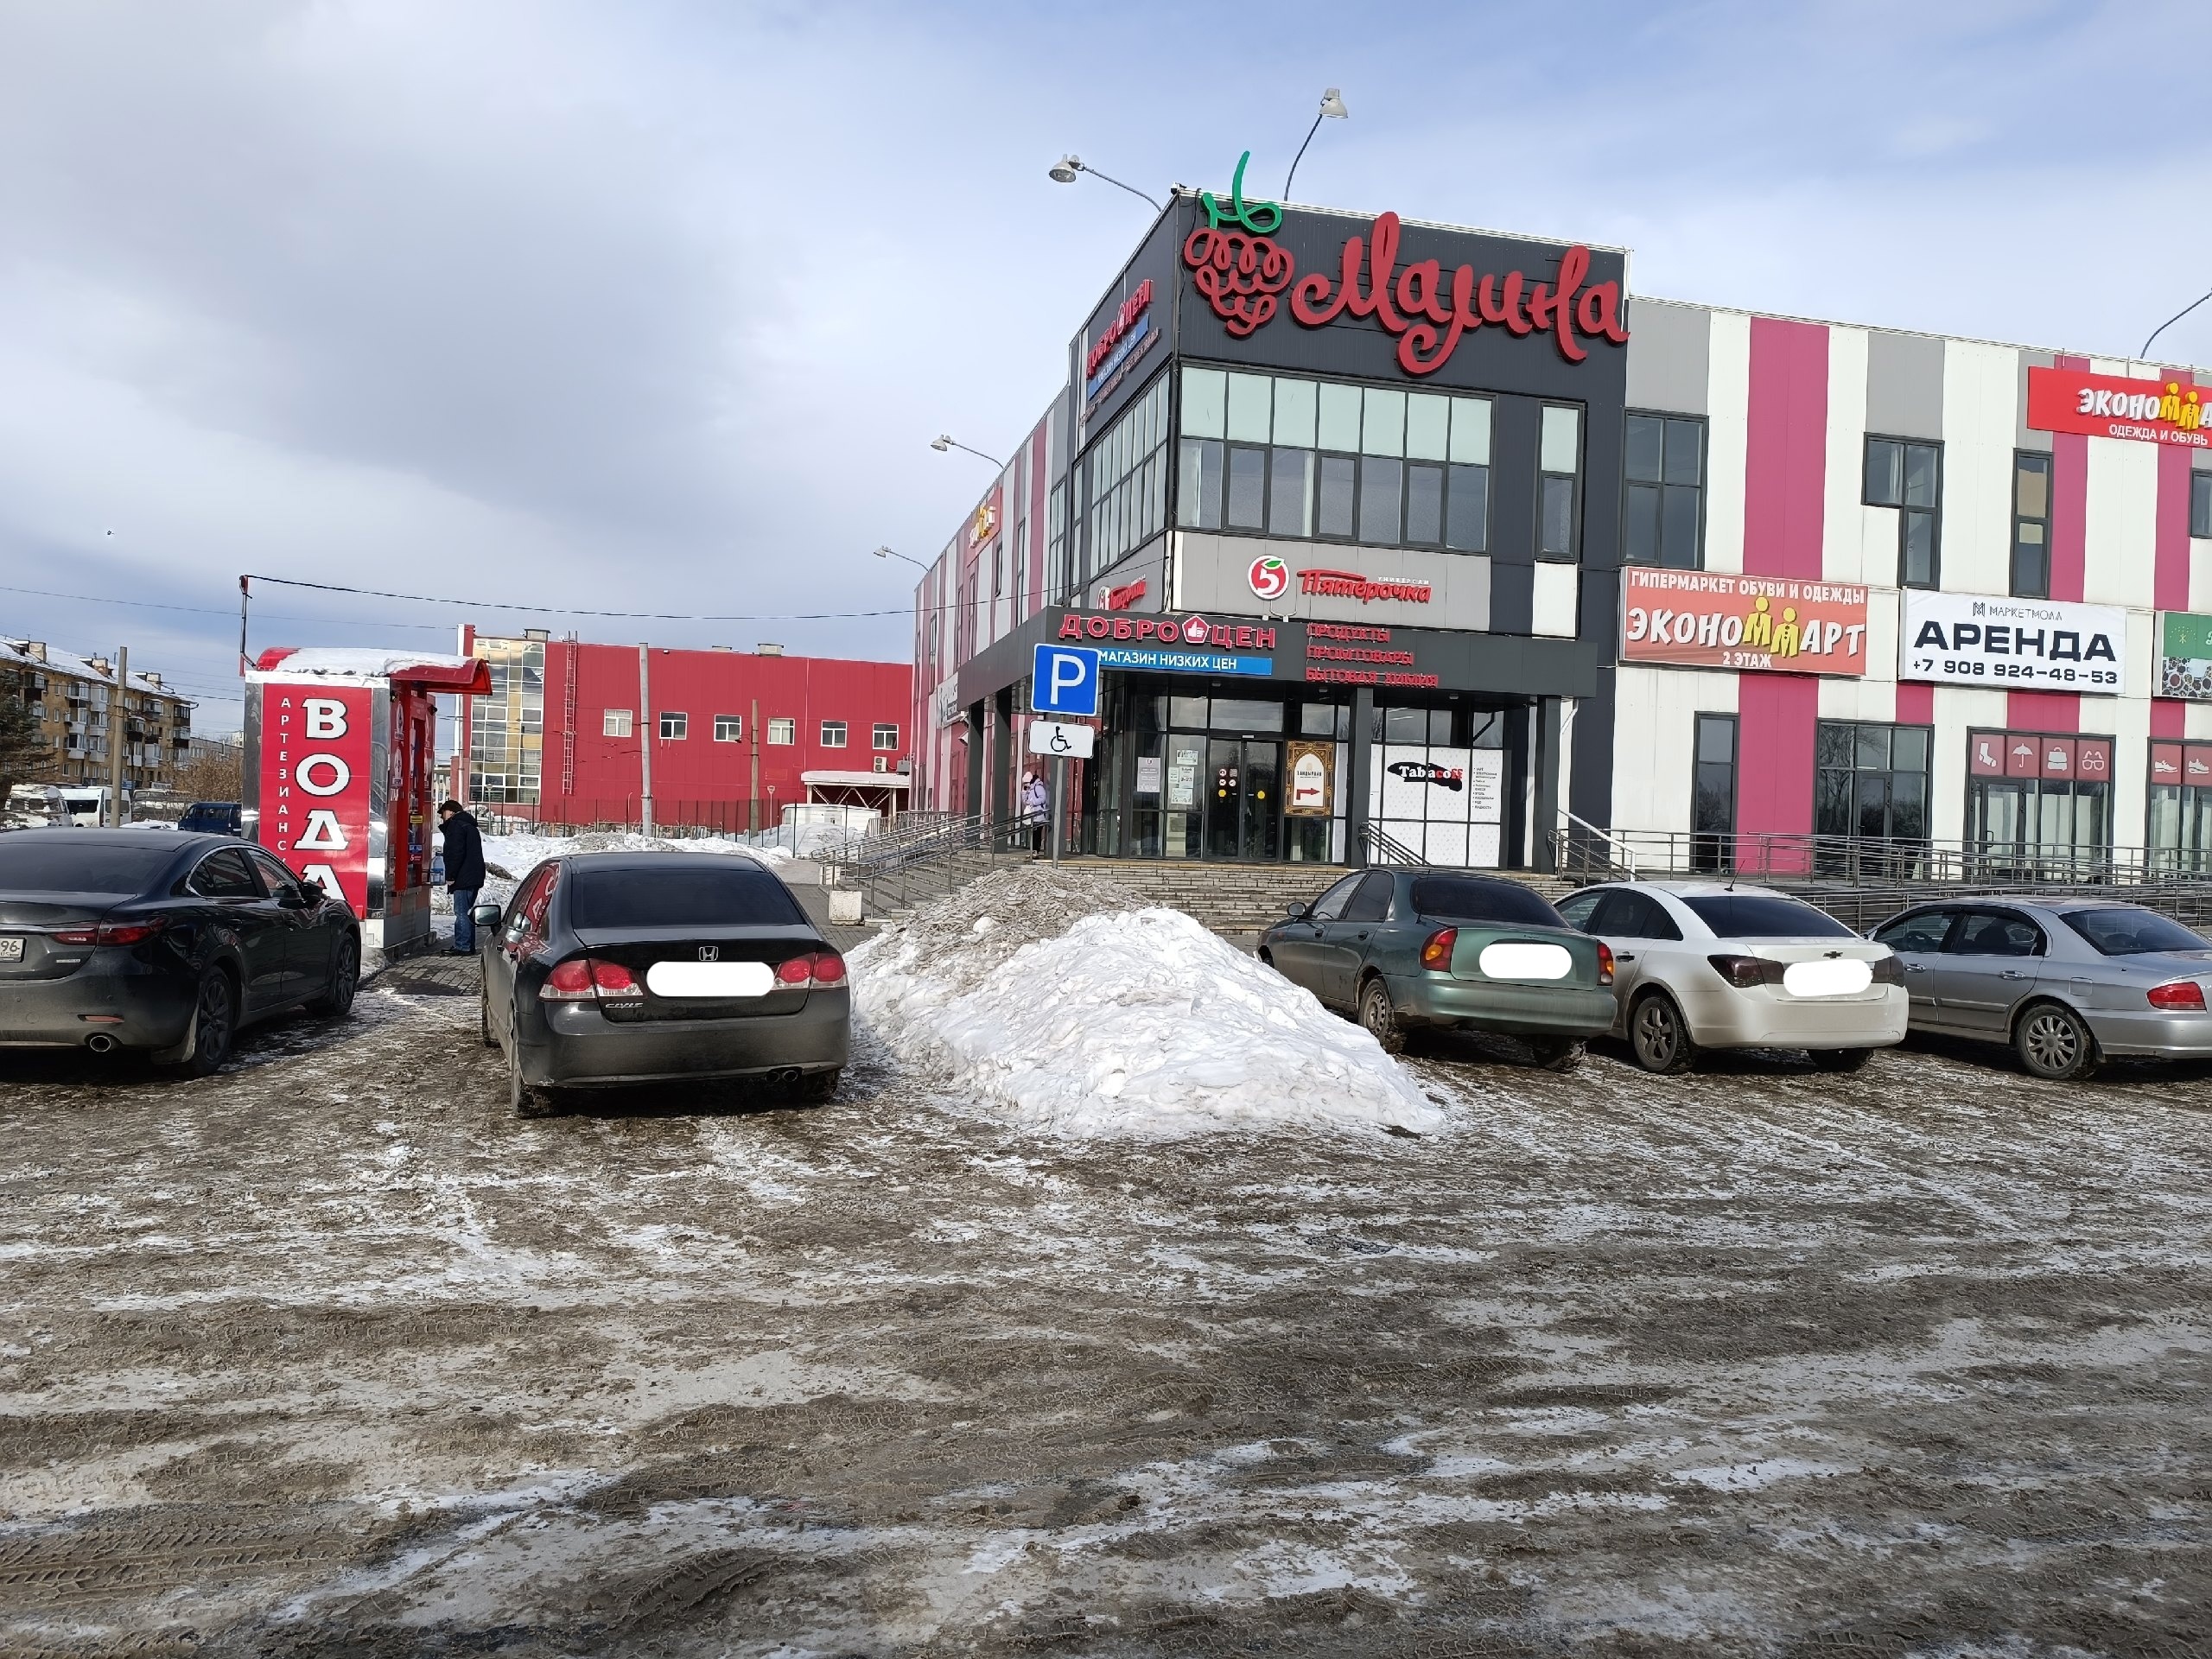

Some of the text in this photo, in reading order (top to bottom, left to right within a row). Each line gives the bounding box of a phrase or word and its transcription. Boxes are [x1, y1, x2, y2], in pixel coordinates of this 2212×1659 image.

[1291, 211, 1630, 375] Малина
[2109, 423, 2209, 446] ОДЕЖДА И ОБУВЬ
[1378, 576, 1429, 585] УНИВЕРСАМ
[1630, 571, 1865, 605] ГИПЕРМАРКЕТ ОБУВИ И ОДЕЖДЫ
[1307, 623, 1390, 642] ПРОДУКТЫ
[1914, 620, 2117, 662] АРЕНДА
[1099, 651, 1237, 671] МАГАЗИН НИЗКИХ ЦЕН
[1307, 645, 1414, 665] ПРОМТОВАРЫ
[1723, 652, 1772, 668] 2 ЭТАЖ
[1306, 667, 1438, 688] БЫТОВАЯ ХИМИЯ
[1914, 658, 2118, 684] +7 908 924-48-53
[277, 697, 291, 864] АРТЕЗИАНС
[1399, 766, 1464, 779] Tabacoff
[294, 697, 351, 900] ВОДА
